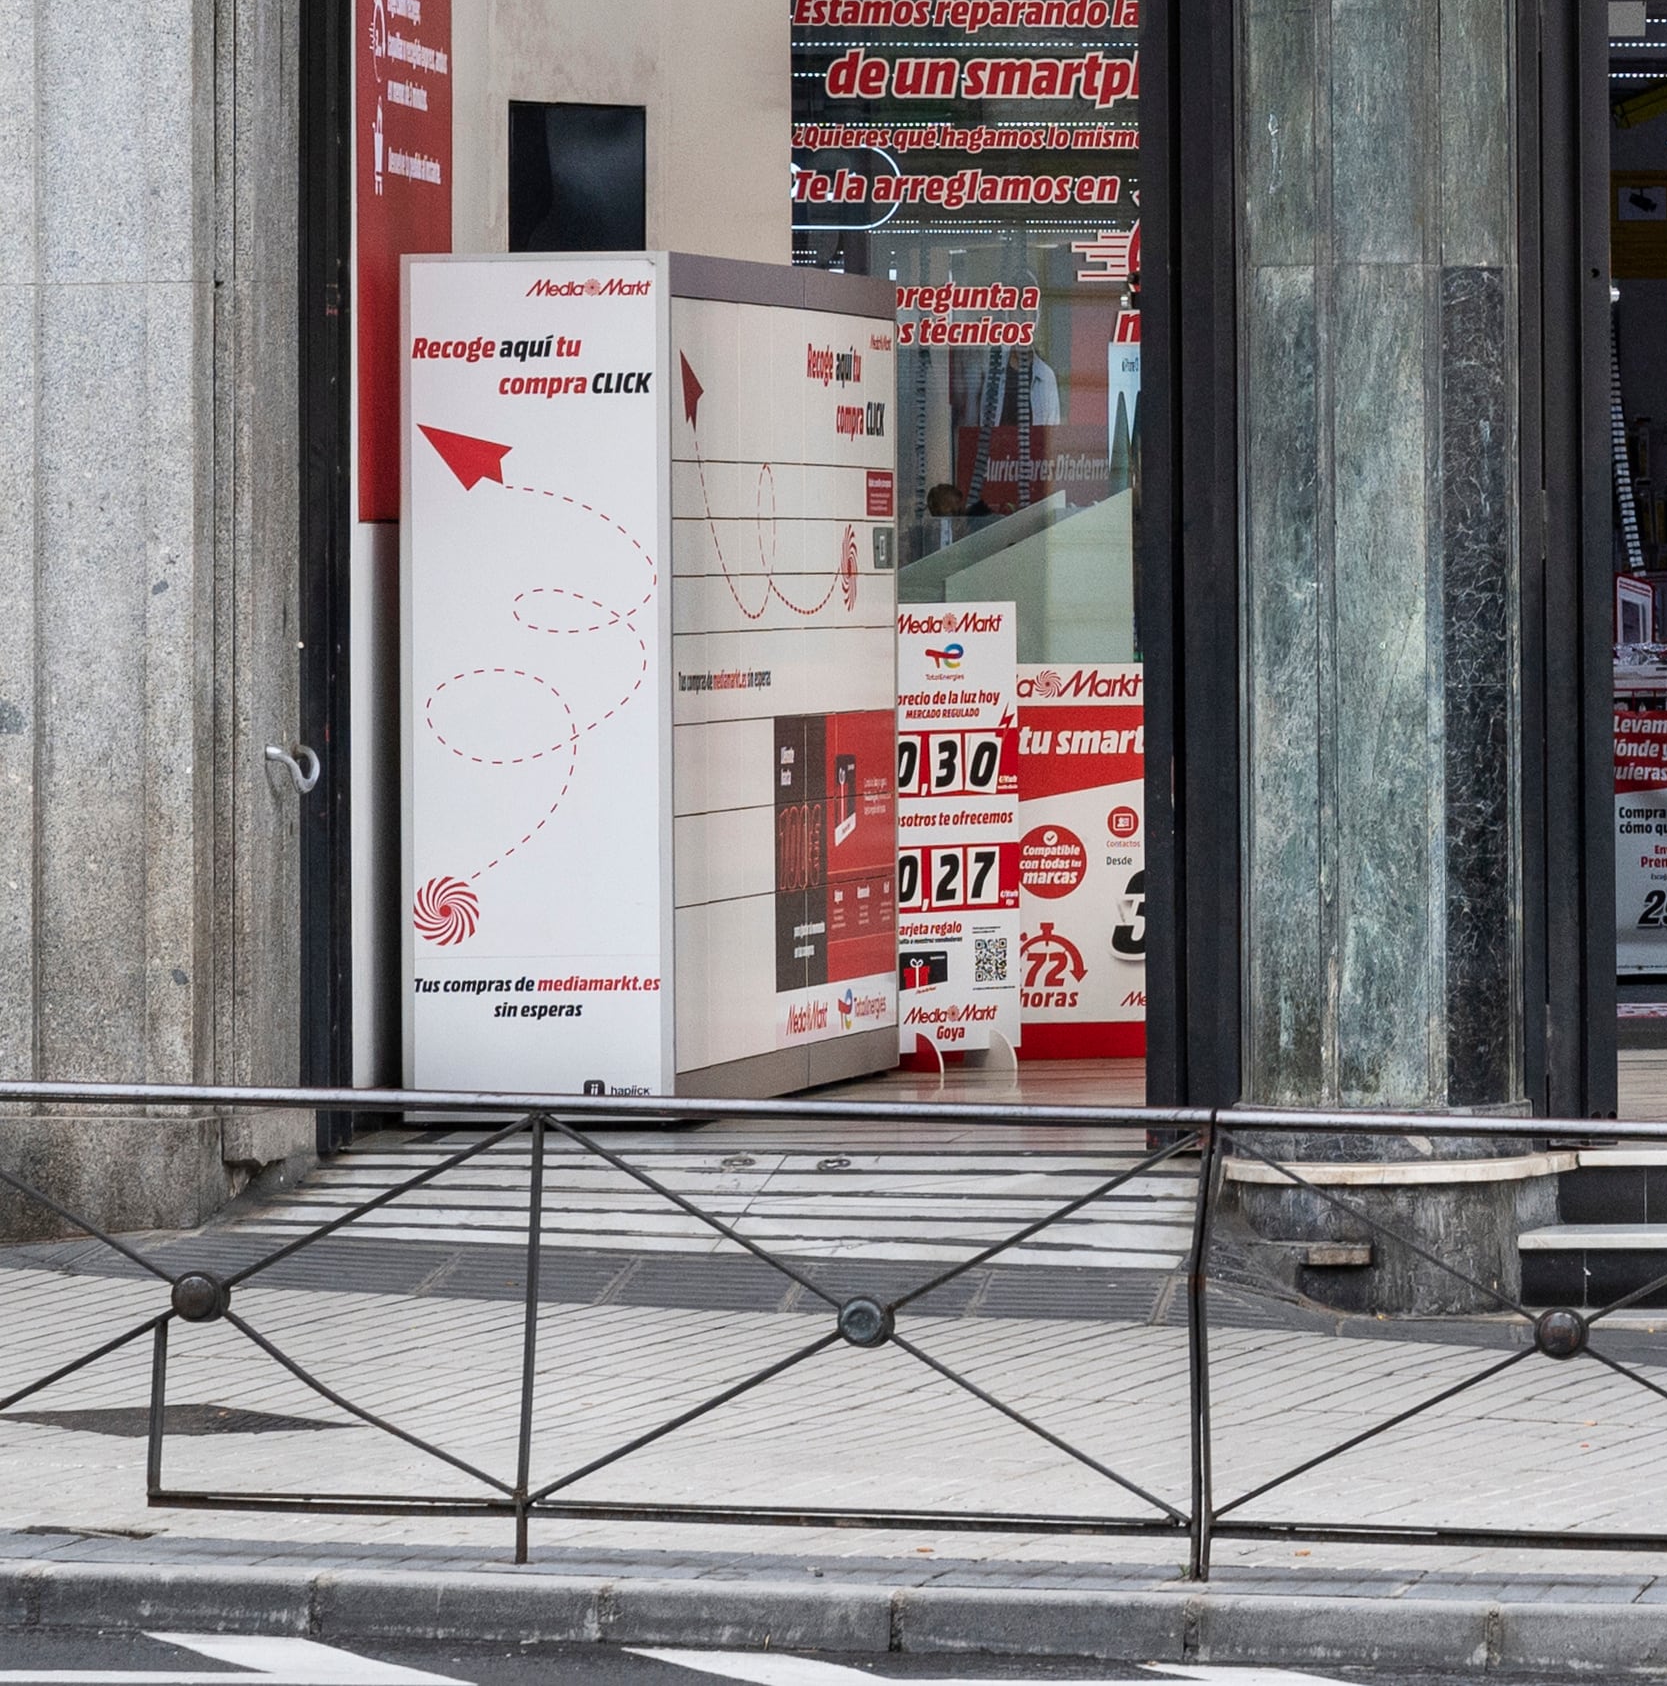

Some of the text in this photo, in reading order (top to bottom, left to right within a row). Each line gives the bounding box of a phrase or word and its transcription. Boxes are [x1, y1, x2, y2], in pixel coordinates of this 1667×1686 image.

[826, 47, 960, 99] de un
[939, 125, 1046, 154] hagamos
[795, 168, 1120, 209] Te la arreglamos en
[1021, 286, 1040, 311] a
[918, 315, 1036, 347] técnicos
[412, 335, 582, 363] Recoge aquí tu
[806, 343, 834, 387] Recoge
[498, 371, 653, 399] compra CLICK
[836, 405, 864, 442] compra
[954, 611, 1003, 633] Markt
[1056, 669, 1144, 698] Markt
[978, 690, 1001, 706] hoy
[905, 707, 980, 720] MERCADO REGULADO
[1018, 727, 1053, 755] tu
[951, 810, 1014, 826] ofrecemos
[1619, 805, 1667, 820] Compra
[1619, 822, 1653, 834] cómo
[1022, 843, 1081, 857] Compatible
[1106, 856, 1133, 866] Desde
[1022, 870, 1078, 885] marcas
[930, 921, 963, 937] regalo
[1024, 952, 1069, 988] 72
[414, 975, 661, 996] Tus compras de mediamarkt.es
[1019, 991, 1079, 1008] horas
[494, 1002, 583, 1021] sin esperas
[903, 1006, 948, 1025] Media
[936, 1024, 966, 1041] Goya
